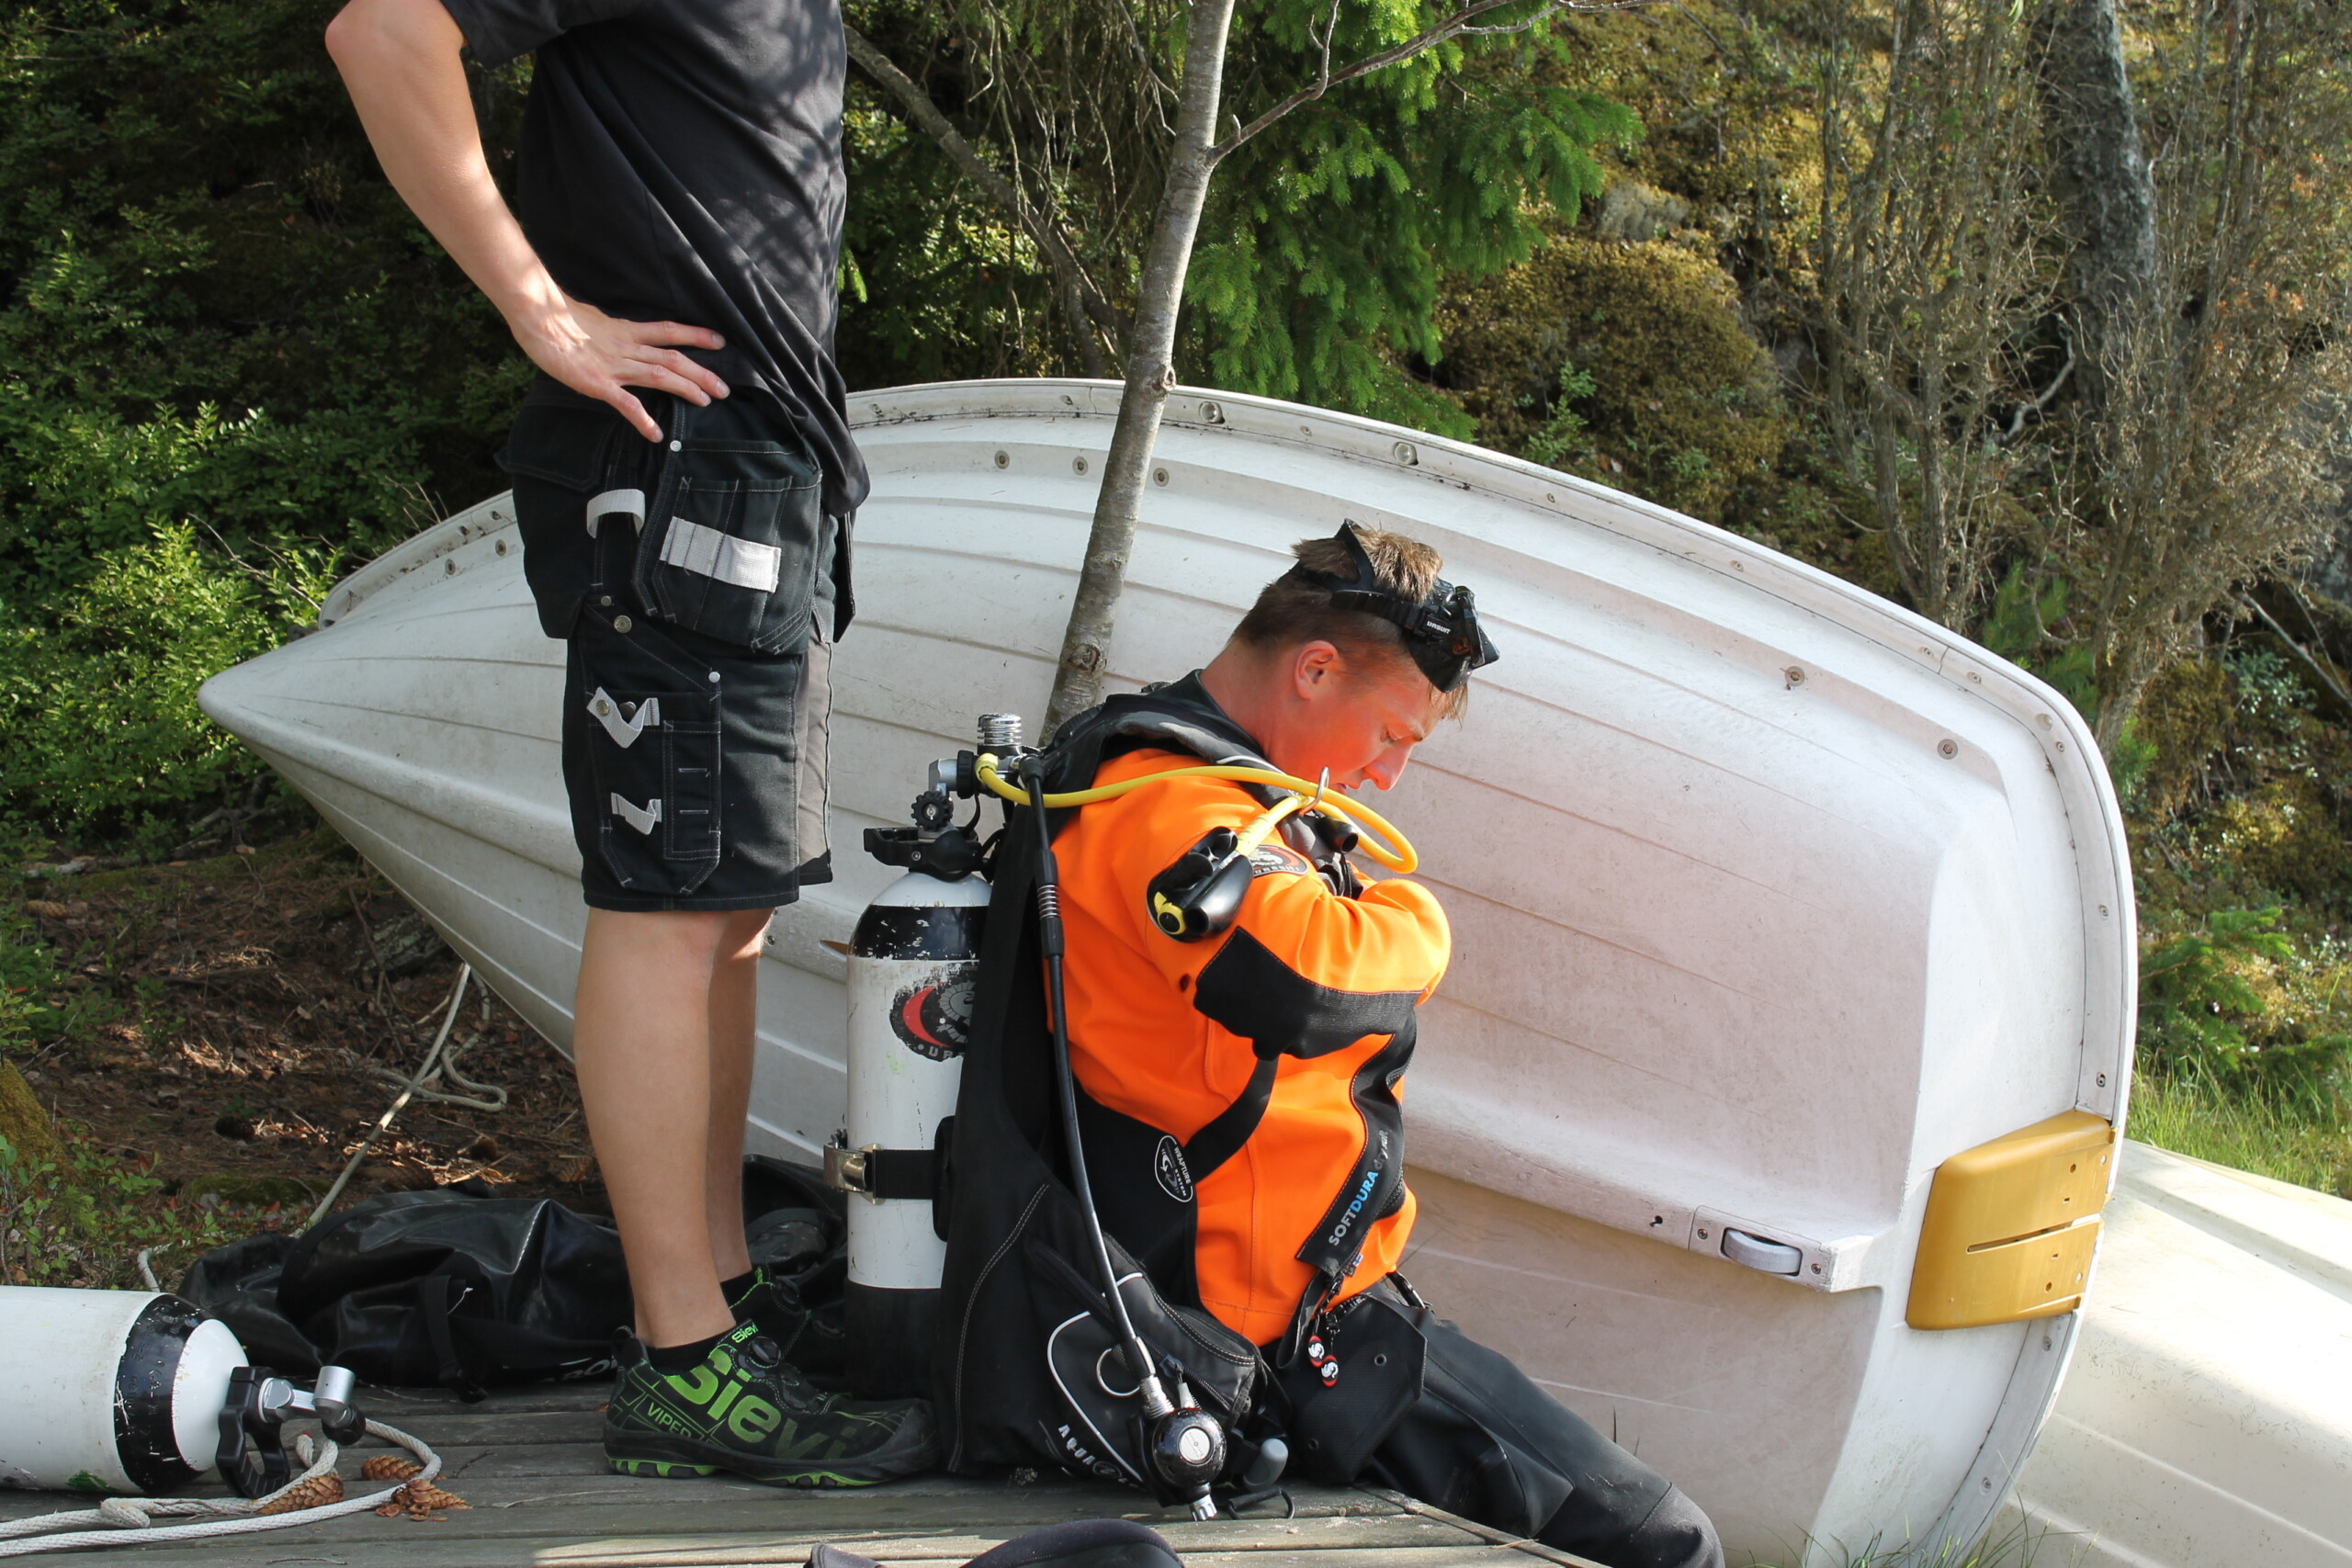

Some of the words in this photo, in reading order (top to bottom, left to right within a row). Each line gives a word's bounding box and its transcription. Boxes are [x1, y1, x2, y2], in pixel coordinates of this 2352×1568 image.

[1427, 620, 1451, 634] URSUIT
[1174, 1146, 1192, 1184] WRAPTURE
[1329, 1170, 1378, 1246] SOFTDURA
[731, 1323, 759, 1344] Sievi
[666, 1348, 856, 1460] Sievi
[1058, 1424, 1096, 1465] AQUA
